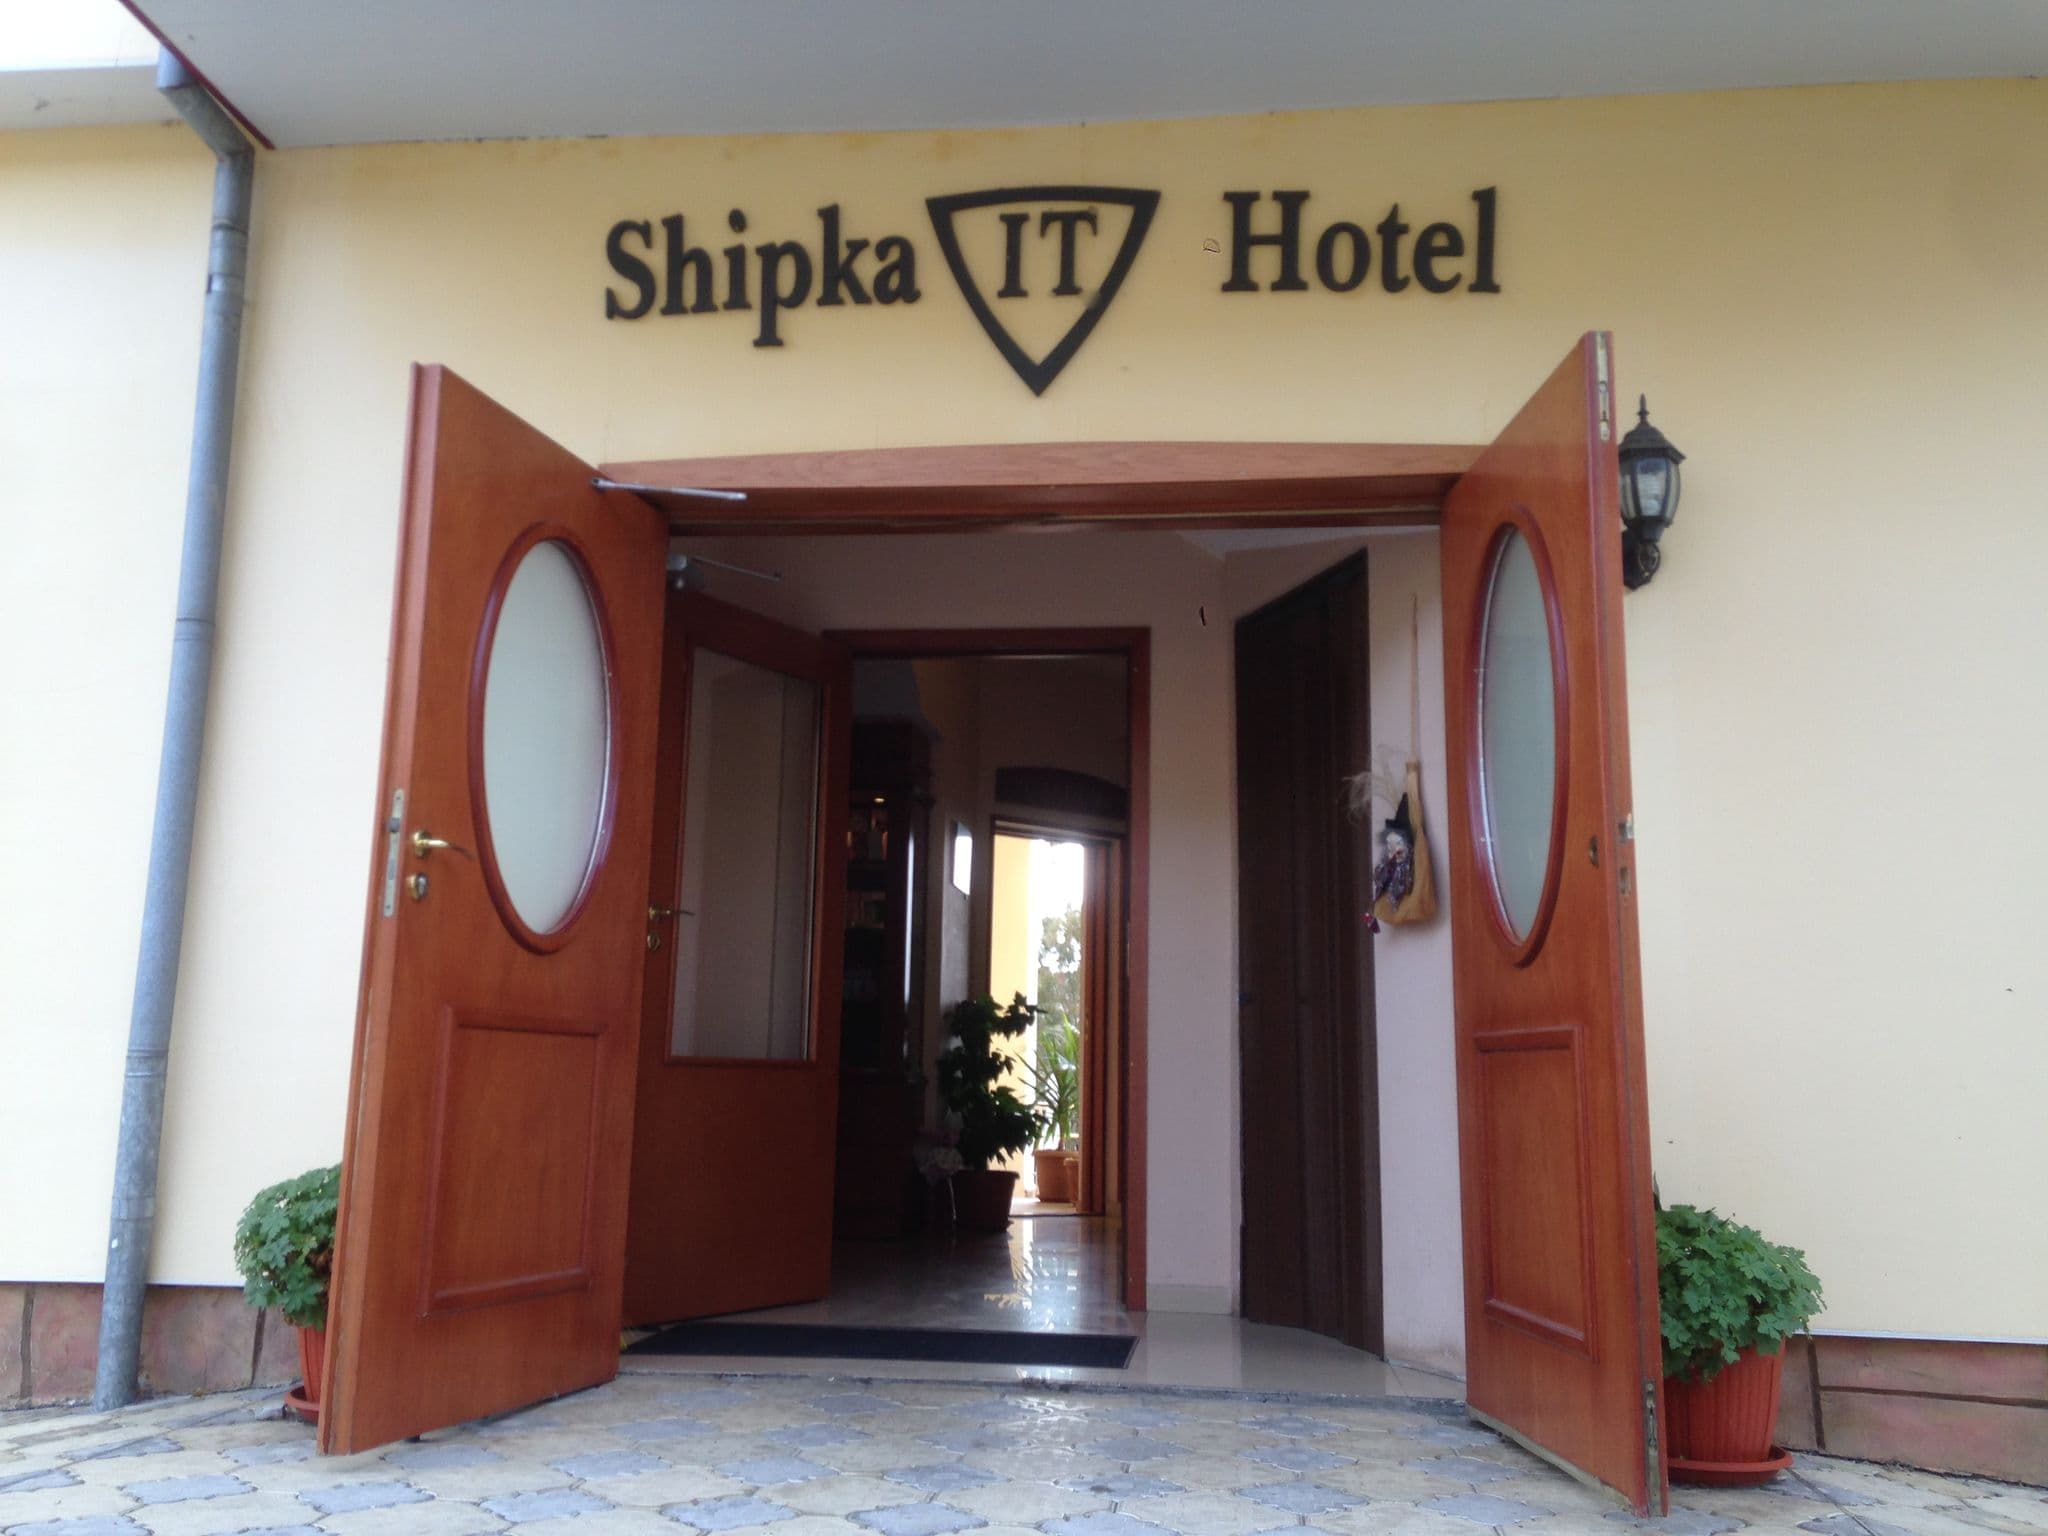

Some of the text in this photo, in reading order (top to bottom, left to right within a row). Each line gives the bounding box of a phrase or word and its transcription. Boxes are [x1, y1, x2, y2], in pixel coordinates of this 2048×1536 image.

[605, 185, 1502, 348] Shipka IT Hotel
